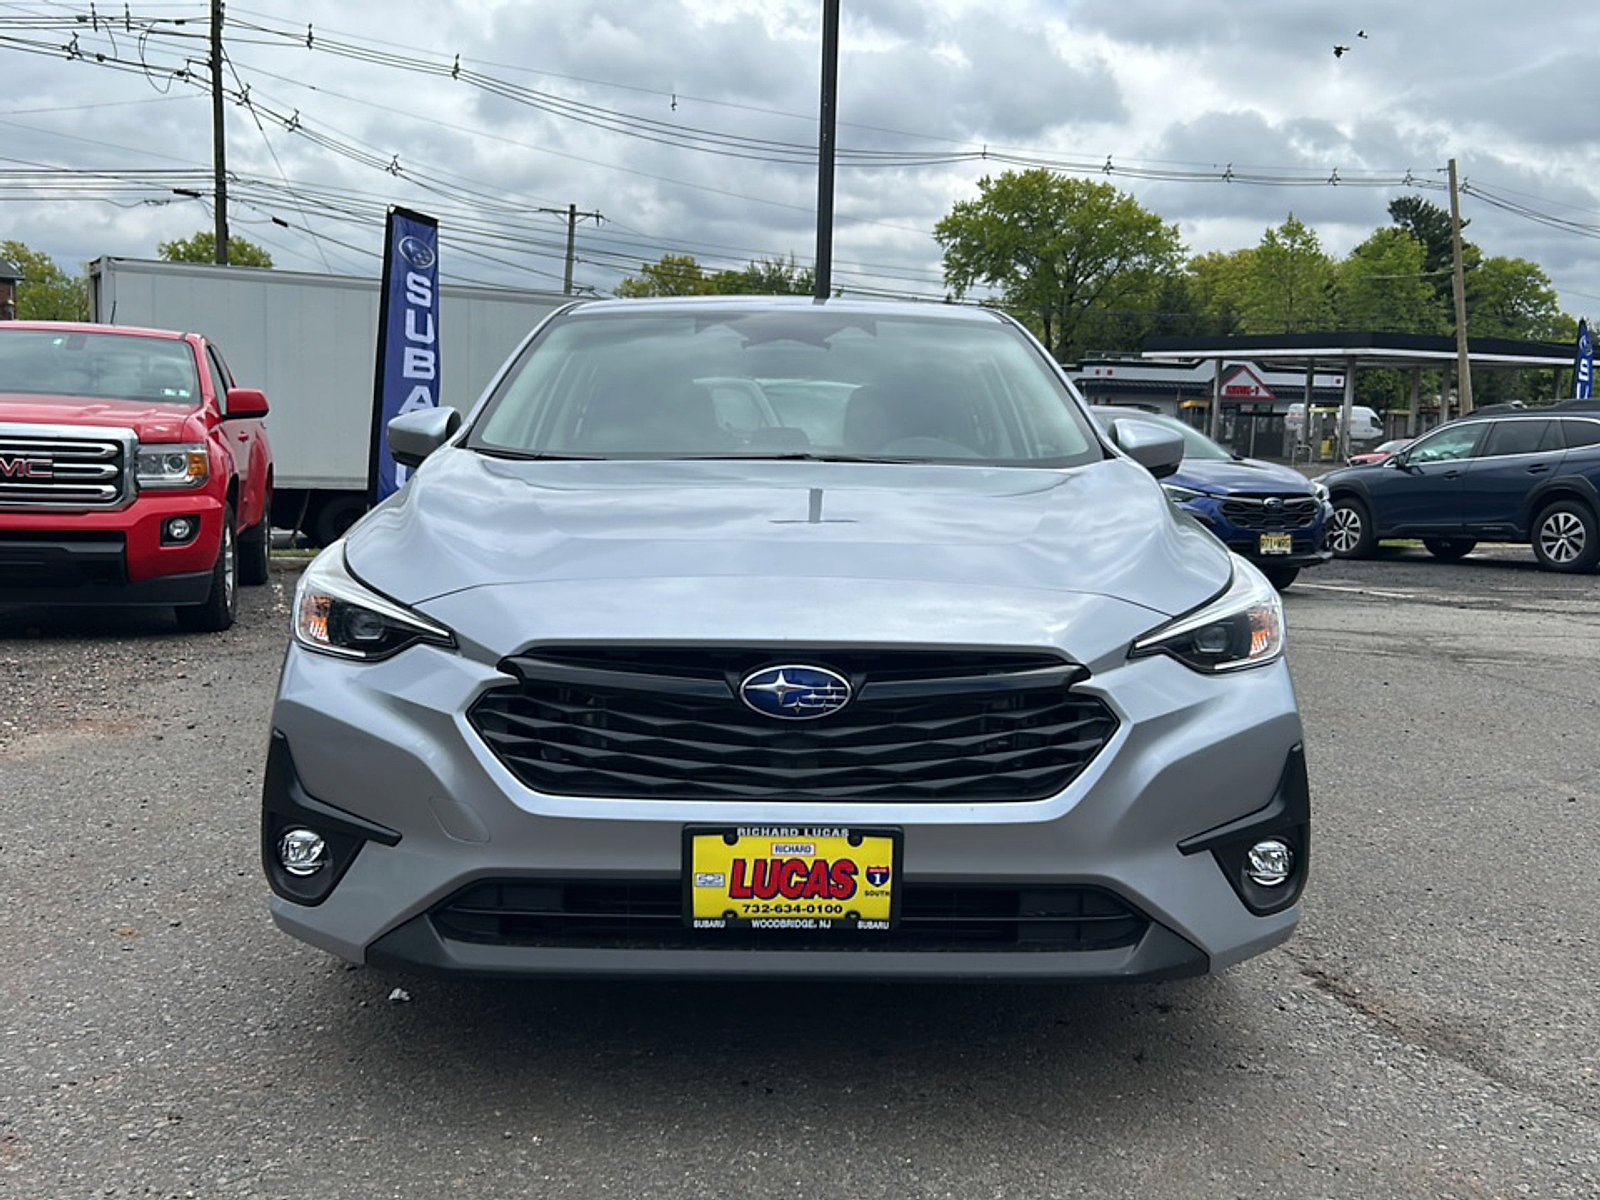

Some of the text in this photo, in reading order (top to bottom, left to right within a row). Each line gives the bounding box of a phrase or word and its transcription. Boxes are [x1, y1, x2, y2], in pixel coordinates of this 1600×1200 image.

[0, 457, 53, 478] MC
[736, 828, 849, 837] RICHARD LUCAS
[774, 845, 812, 853] RICHARD
[728, 858, 859, 900] LUCAS
[742, 904, 843, 914] 732-634-0100
[694, 920, 726, 928] SUBARU
[819, 919, 832, 928] NJ
[857, 921, 889, 929] SUBARU
